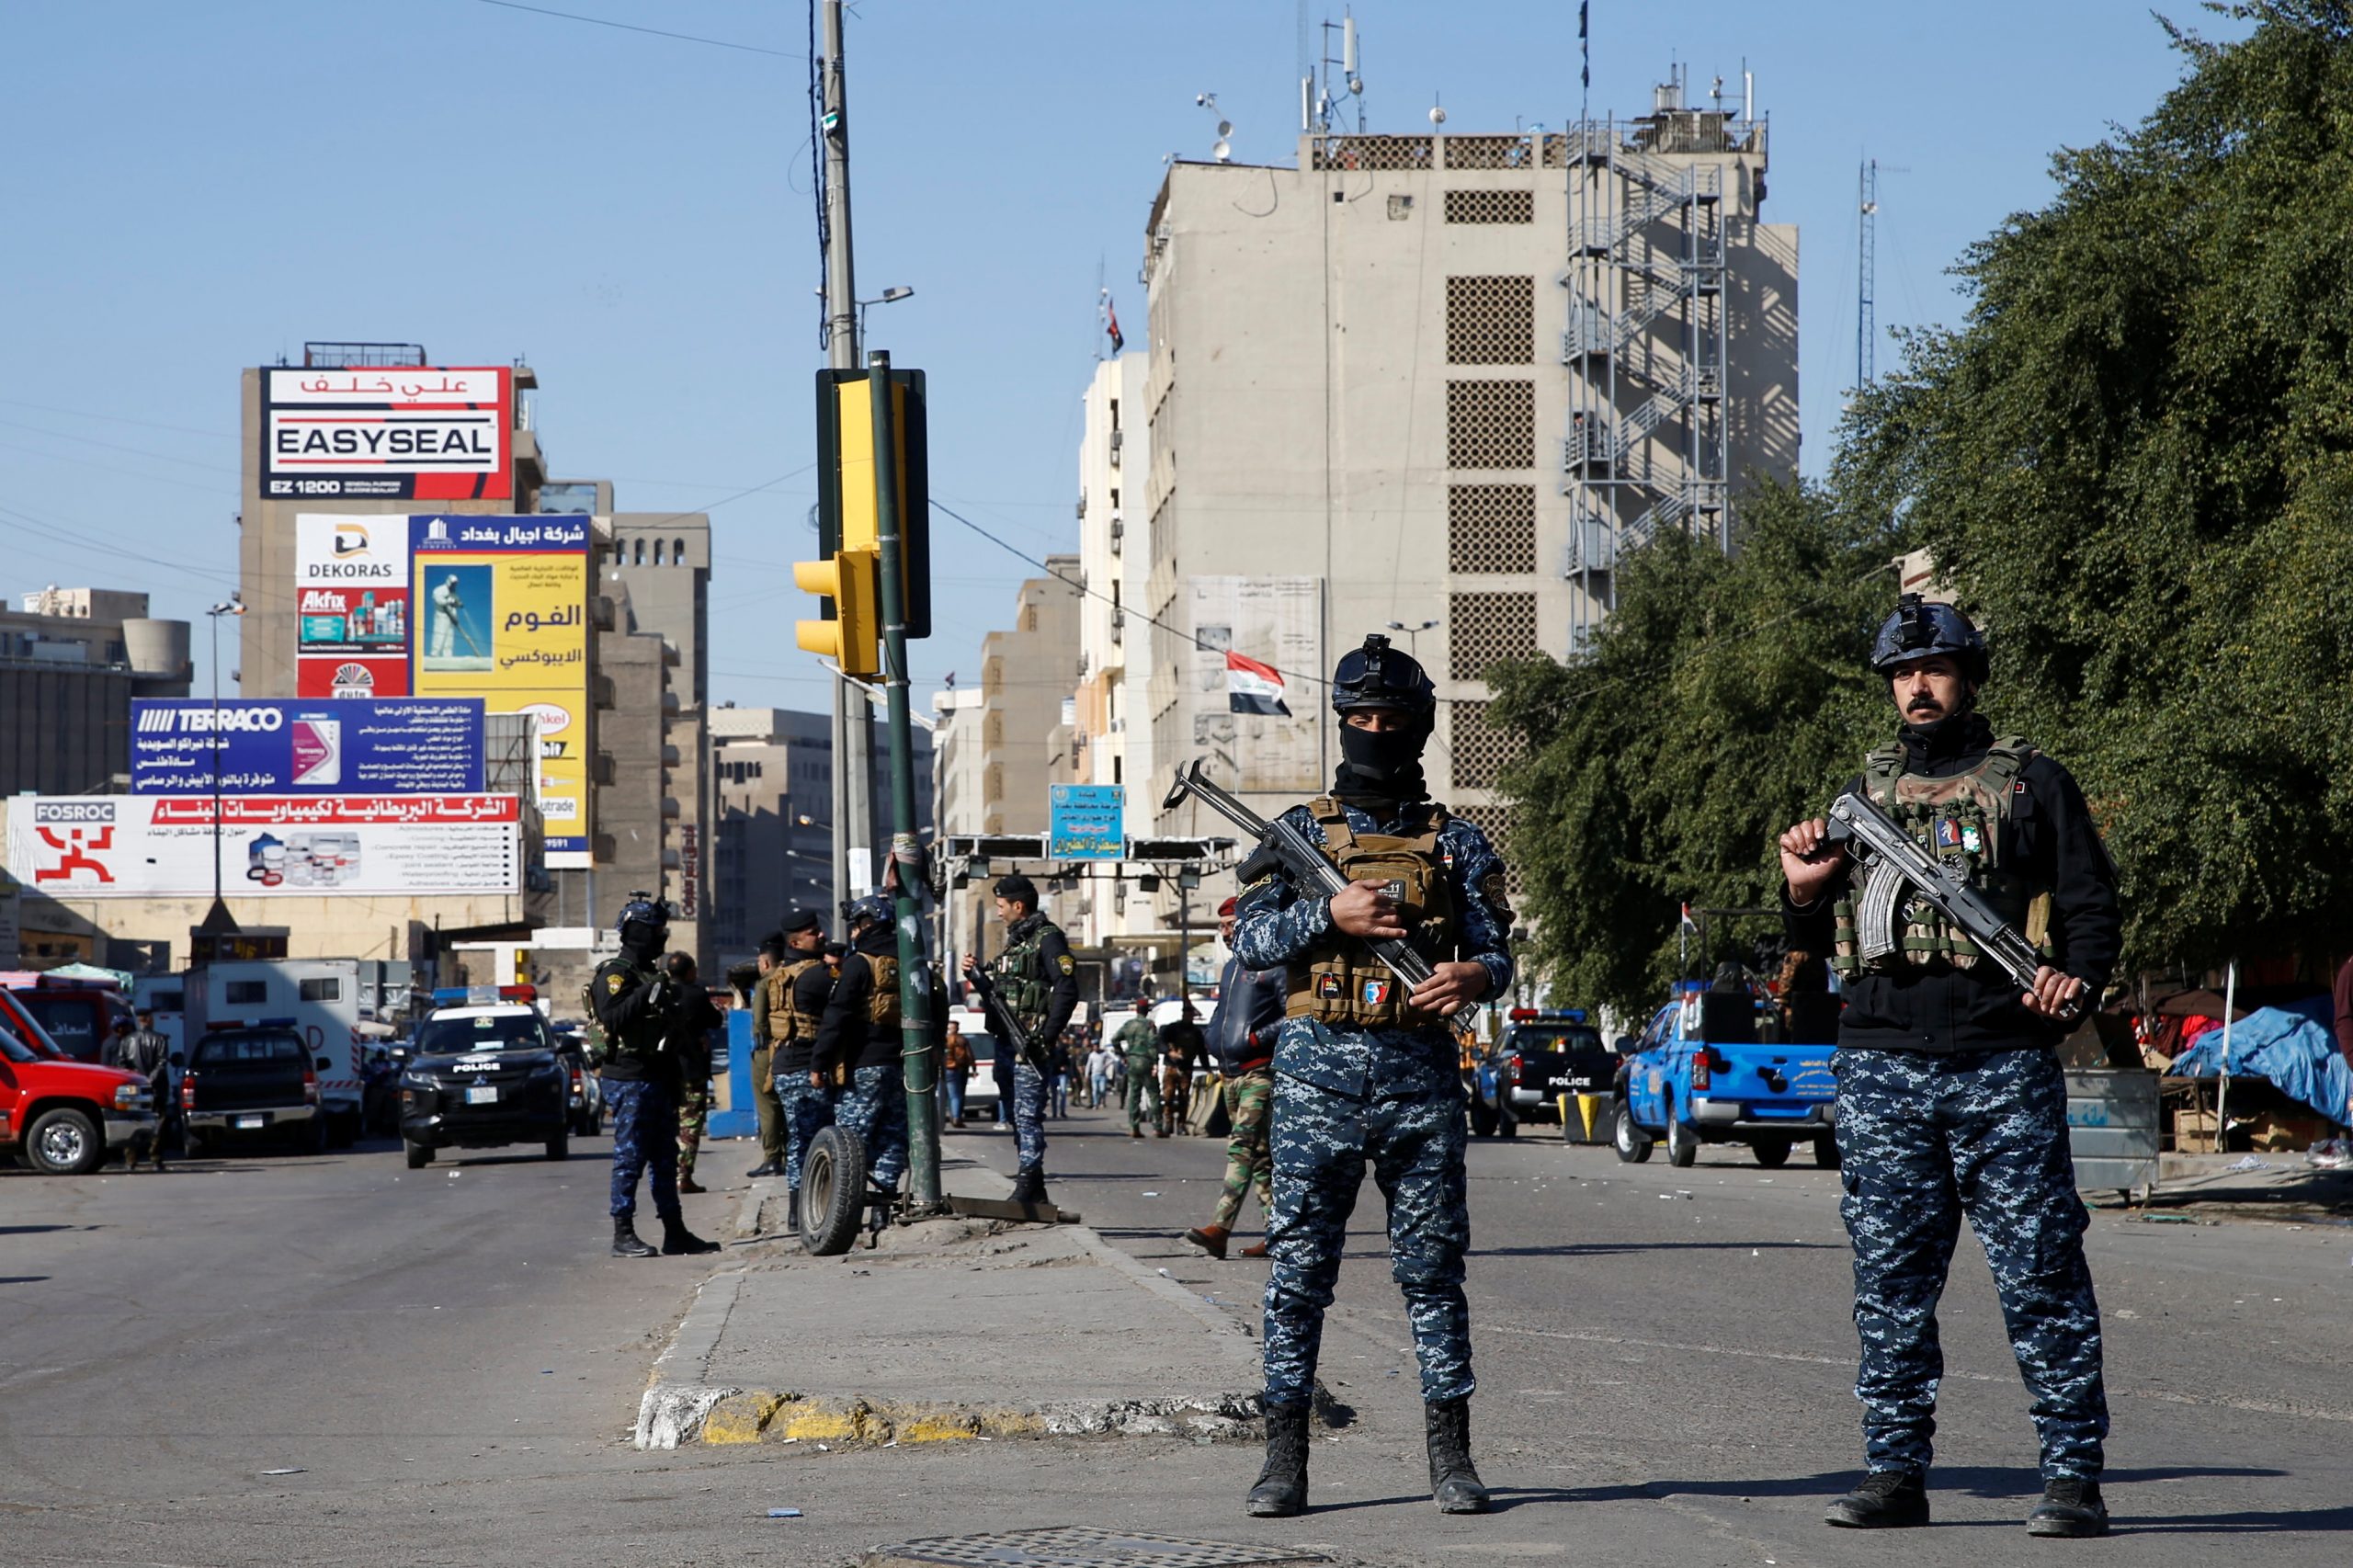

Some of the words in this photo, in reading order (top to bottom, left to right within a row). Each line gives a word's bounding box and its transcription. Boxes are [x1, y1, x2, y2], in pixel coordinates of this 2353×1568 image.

[301, 374, 393, 392] خلف
[402, 378, 468, 402] علي
[278, 429, 492, 453] EASYSEAL
[270, 481, 292, 494] EZ
[295, 481, 340, 494] 1200
[460, 526, 500, 545] بغداد
[503, 526, 539, 544] اجيال
[543, 524, 585, 542] شركة
[309, 563, 392, 578] DEKORAS
[301, 591, 347, 608] Akfix
[505, 604, 581, 632] الفوم
[499, 648, 582, 670] الايبوكسي
[178, 707, 283, 732] TERRACO
[541, 741, 563, 757] bit
[36, 805, 114, 821] FOSROC
[335, 798, 433, 822] البريطانية
[436, 797, 506, 820] الشركة
[202, 826, 226, 837] لافة
[453, 1062, 501, 1074] POLICE
[1548, 1076, 1591, 1086] POLICE
